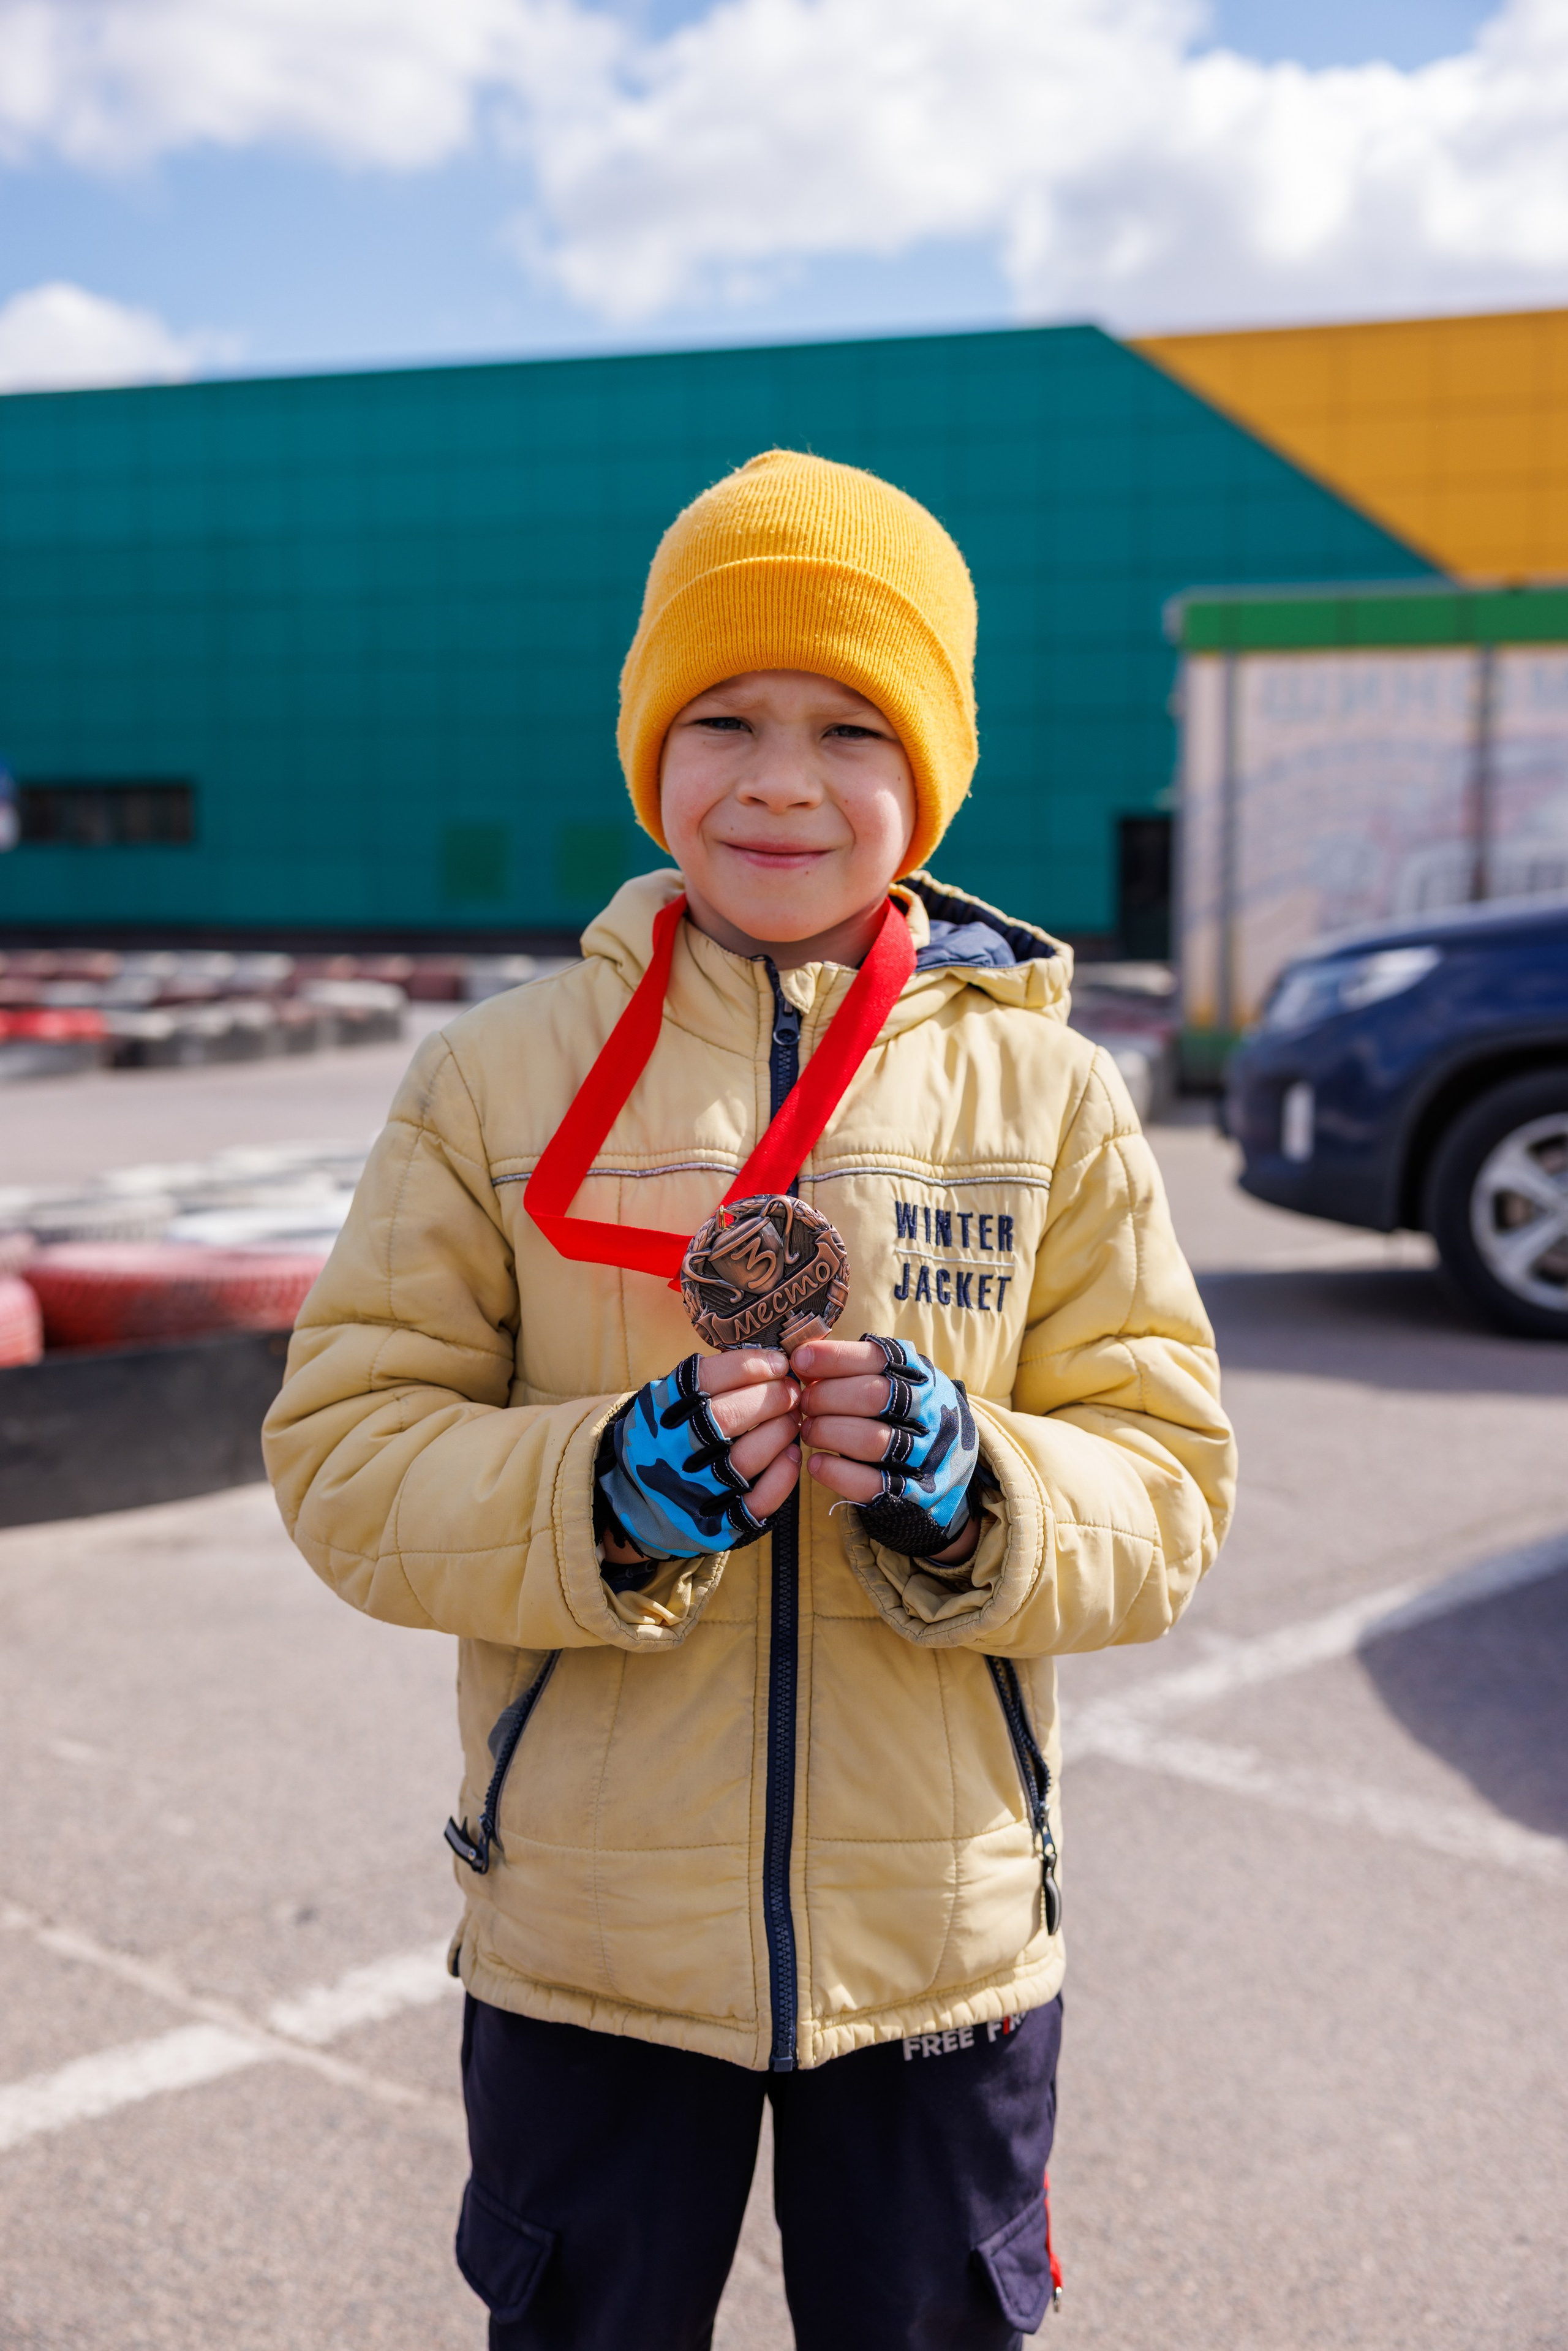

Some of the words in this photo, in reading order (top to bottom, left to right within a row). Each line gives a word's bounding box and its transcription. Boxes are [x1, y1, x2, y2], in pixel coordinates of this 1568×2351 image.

[895, 1201, 1014, 1251] WINTER
[730, 1236, 777, 1289] 3
[894, 1262, 1012, 1312] JACKET
[902, 2026, 975, 2061] FREE
[987, 2010, 1027, 2043] FIR
